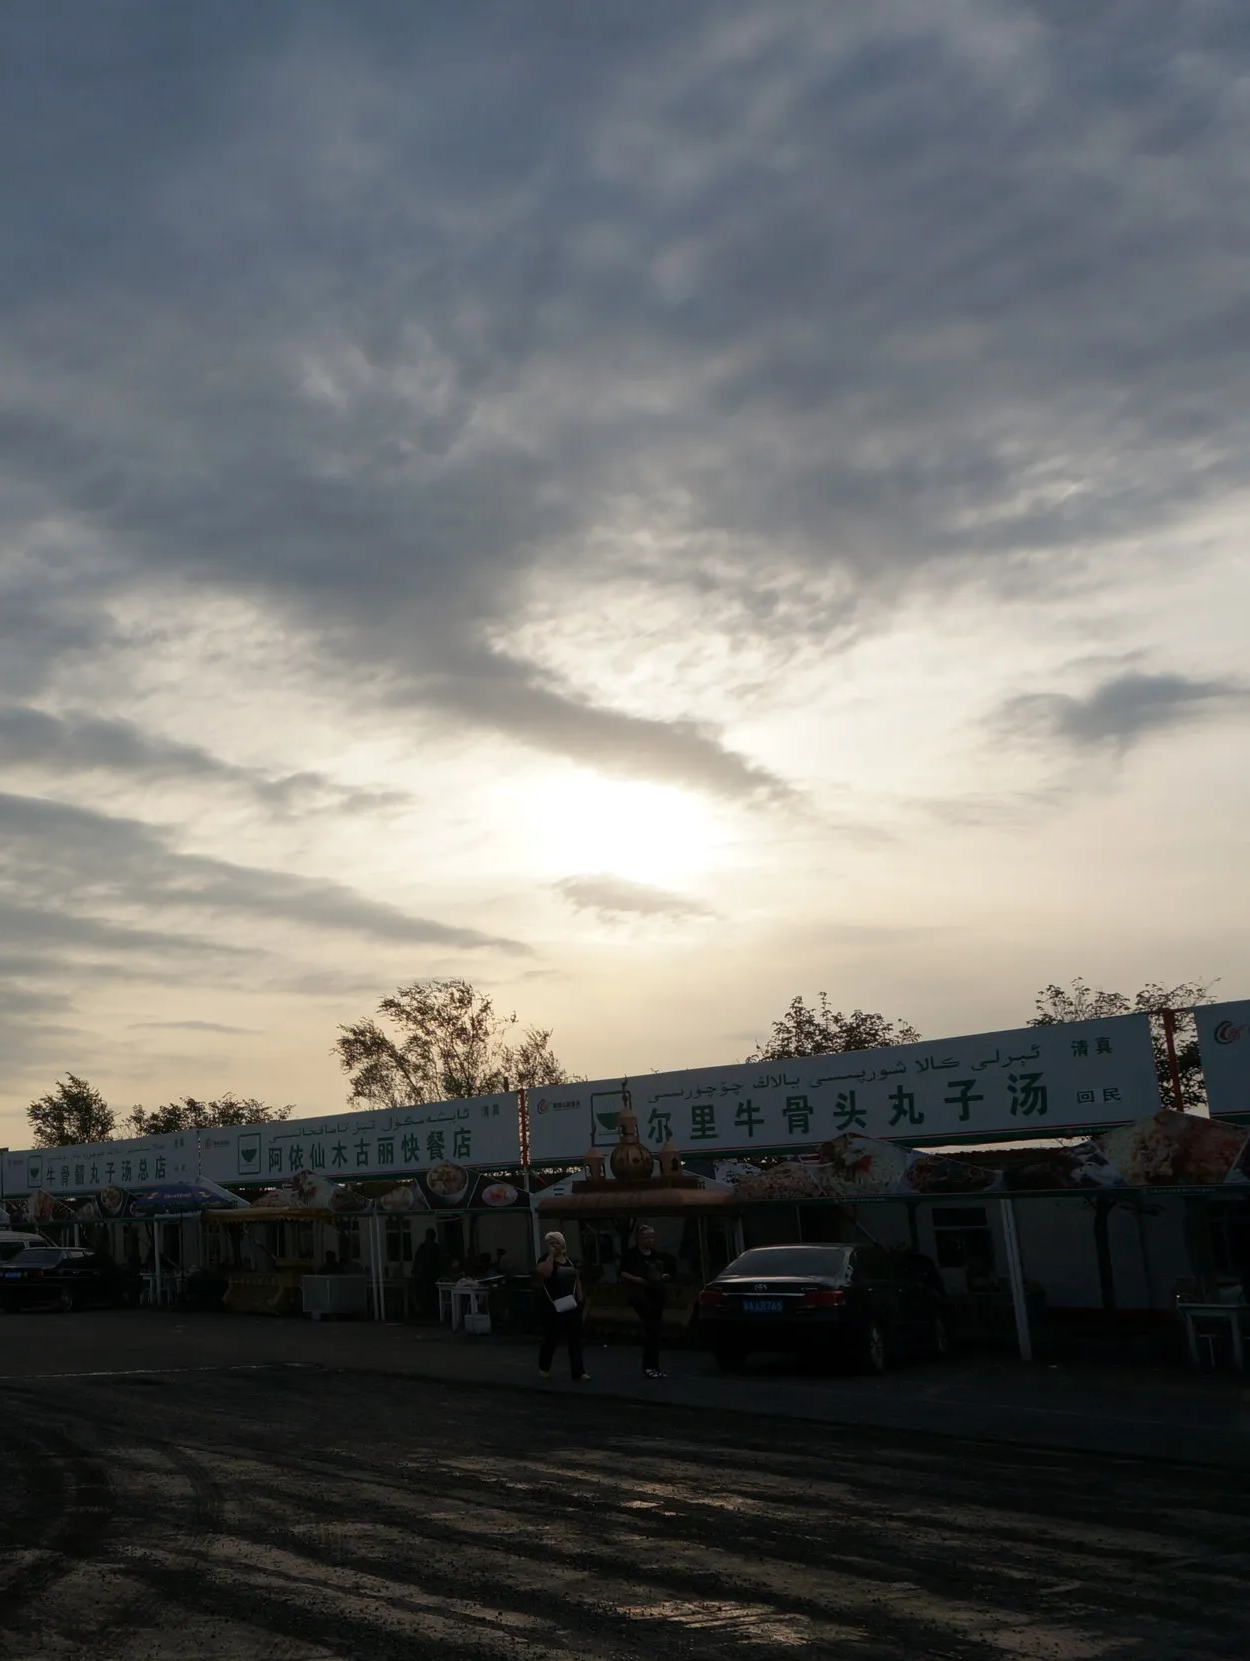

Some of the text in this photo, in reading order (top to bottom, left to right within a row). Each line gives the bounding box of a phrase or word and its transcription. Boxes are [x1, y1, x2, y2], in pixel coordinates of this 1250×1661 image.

[1071, 1037, 1112, 1057] 清真
[648, 1072, 1048, 1144] 尔里牛骨头丸子汤
[1077, 1087, 1122, 1103] 回民
[268, 1127, 472, 1173] 阿依仙木古丽快餐店
